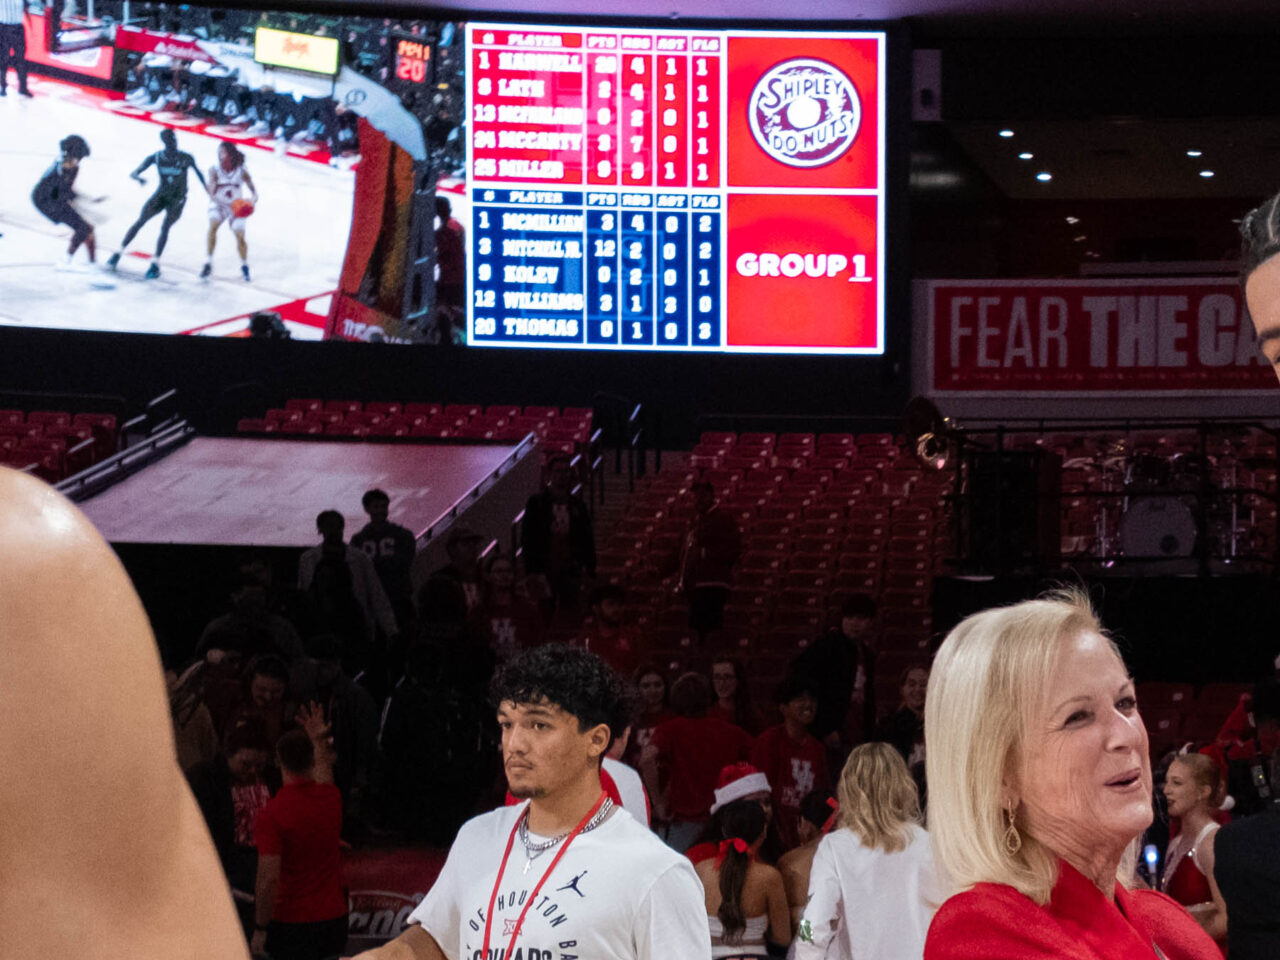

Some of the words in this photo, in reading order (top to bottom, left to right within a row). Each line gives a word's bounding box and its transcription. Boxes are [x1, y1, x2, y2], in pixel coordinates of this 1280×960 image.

[479, 52, 490, 69] 1
[666, 58, 677, 75] 1
[696, 58, 708, 76] 1
[664, 83, 676, 101] 1
[697, 85, 708, 102] 1
[763, 77, 843, 108] SHIPLEY
[697, 111, 708, 128] 1
[630, 135, 644, 153] 7
[697, 137, 708, 155] 1
[664, 162, 676, 179] 1
[697, 164, 708, 181] 1
[509, 191, 563, 203] PLAYER
[588, 193, 616, 206] PTS
[479, 211, 490, 229] 1
[631, 214, 645, 232] 4
[699, 215, 711, 232] 2
[594, 240, 615, 257] 12
[630, 242, 642, 259] 2
[663, 243, 676, 260] 0
[699, 242, 711, 259] 2
[598, 266, 611, 283] 0
[630, 268, 642, 285] 2
[664, 269, 676, 286] 0
[699, 269, 710, 286] 1
[736, 252, 848, 277] GROUP
[848, 254, 873, 282] 1
[475, 290, 495, 307] 12
[503, 291, 583, 310] WILLIAMS
[631, 295, 642, 312] 1
[699, 295, 712, 313] 0
[475, 318, 496, 335] 20
[503, 319, 578, 337] THOMAS
[600, 320, 613, 337] 0
[631, 322, 642, 339] 1
[665, 323, 678, 340] 0
[950, 296, 1069, 368] FEAR
[1082, 295, 1188, 368] THE
[469, 908, 486, 932] OF
